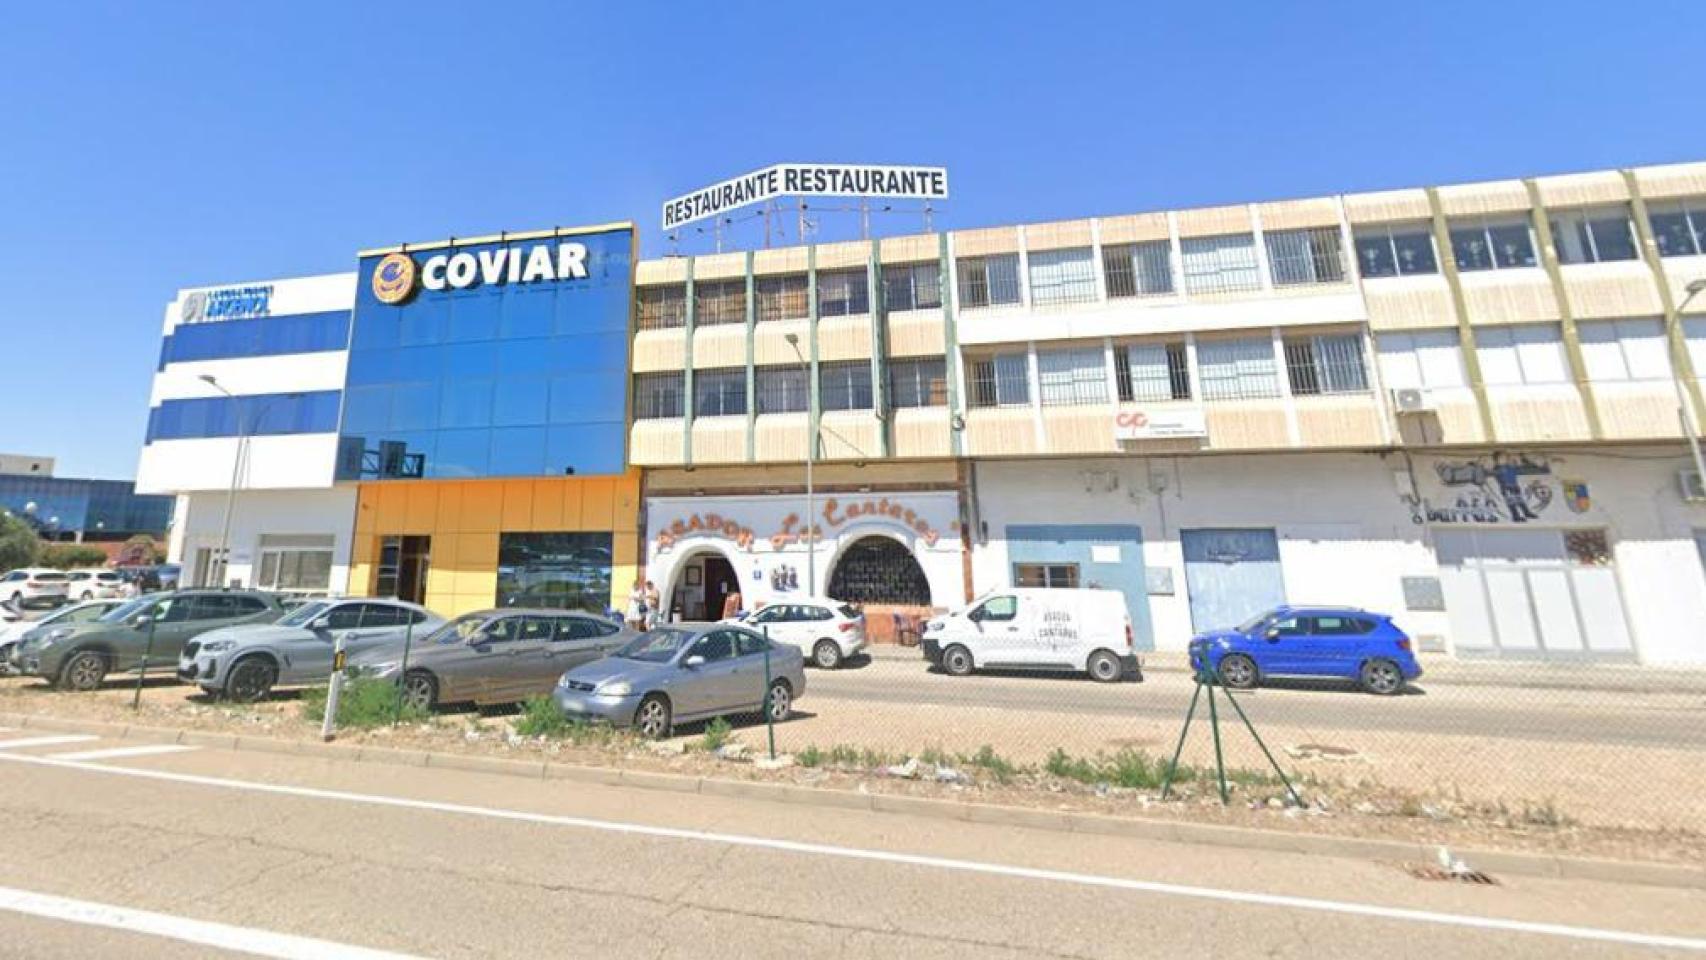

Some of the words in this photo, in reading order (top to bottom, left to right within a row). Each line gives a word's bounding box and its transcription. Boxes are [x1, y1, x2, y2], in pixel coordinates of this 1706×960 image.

[665, 169, 777, 226] RESTAURANTE
[785, 168, 944, 195] RESTAURANTE
[422, 242, 588, 291] COVIAR
[656, 513, 754, 552] ASADOR
